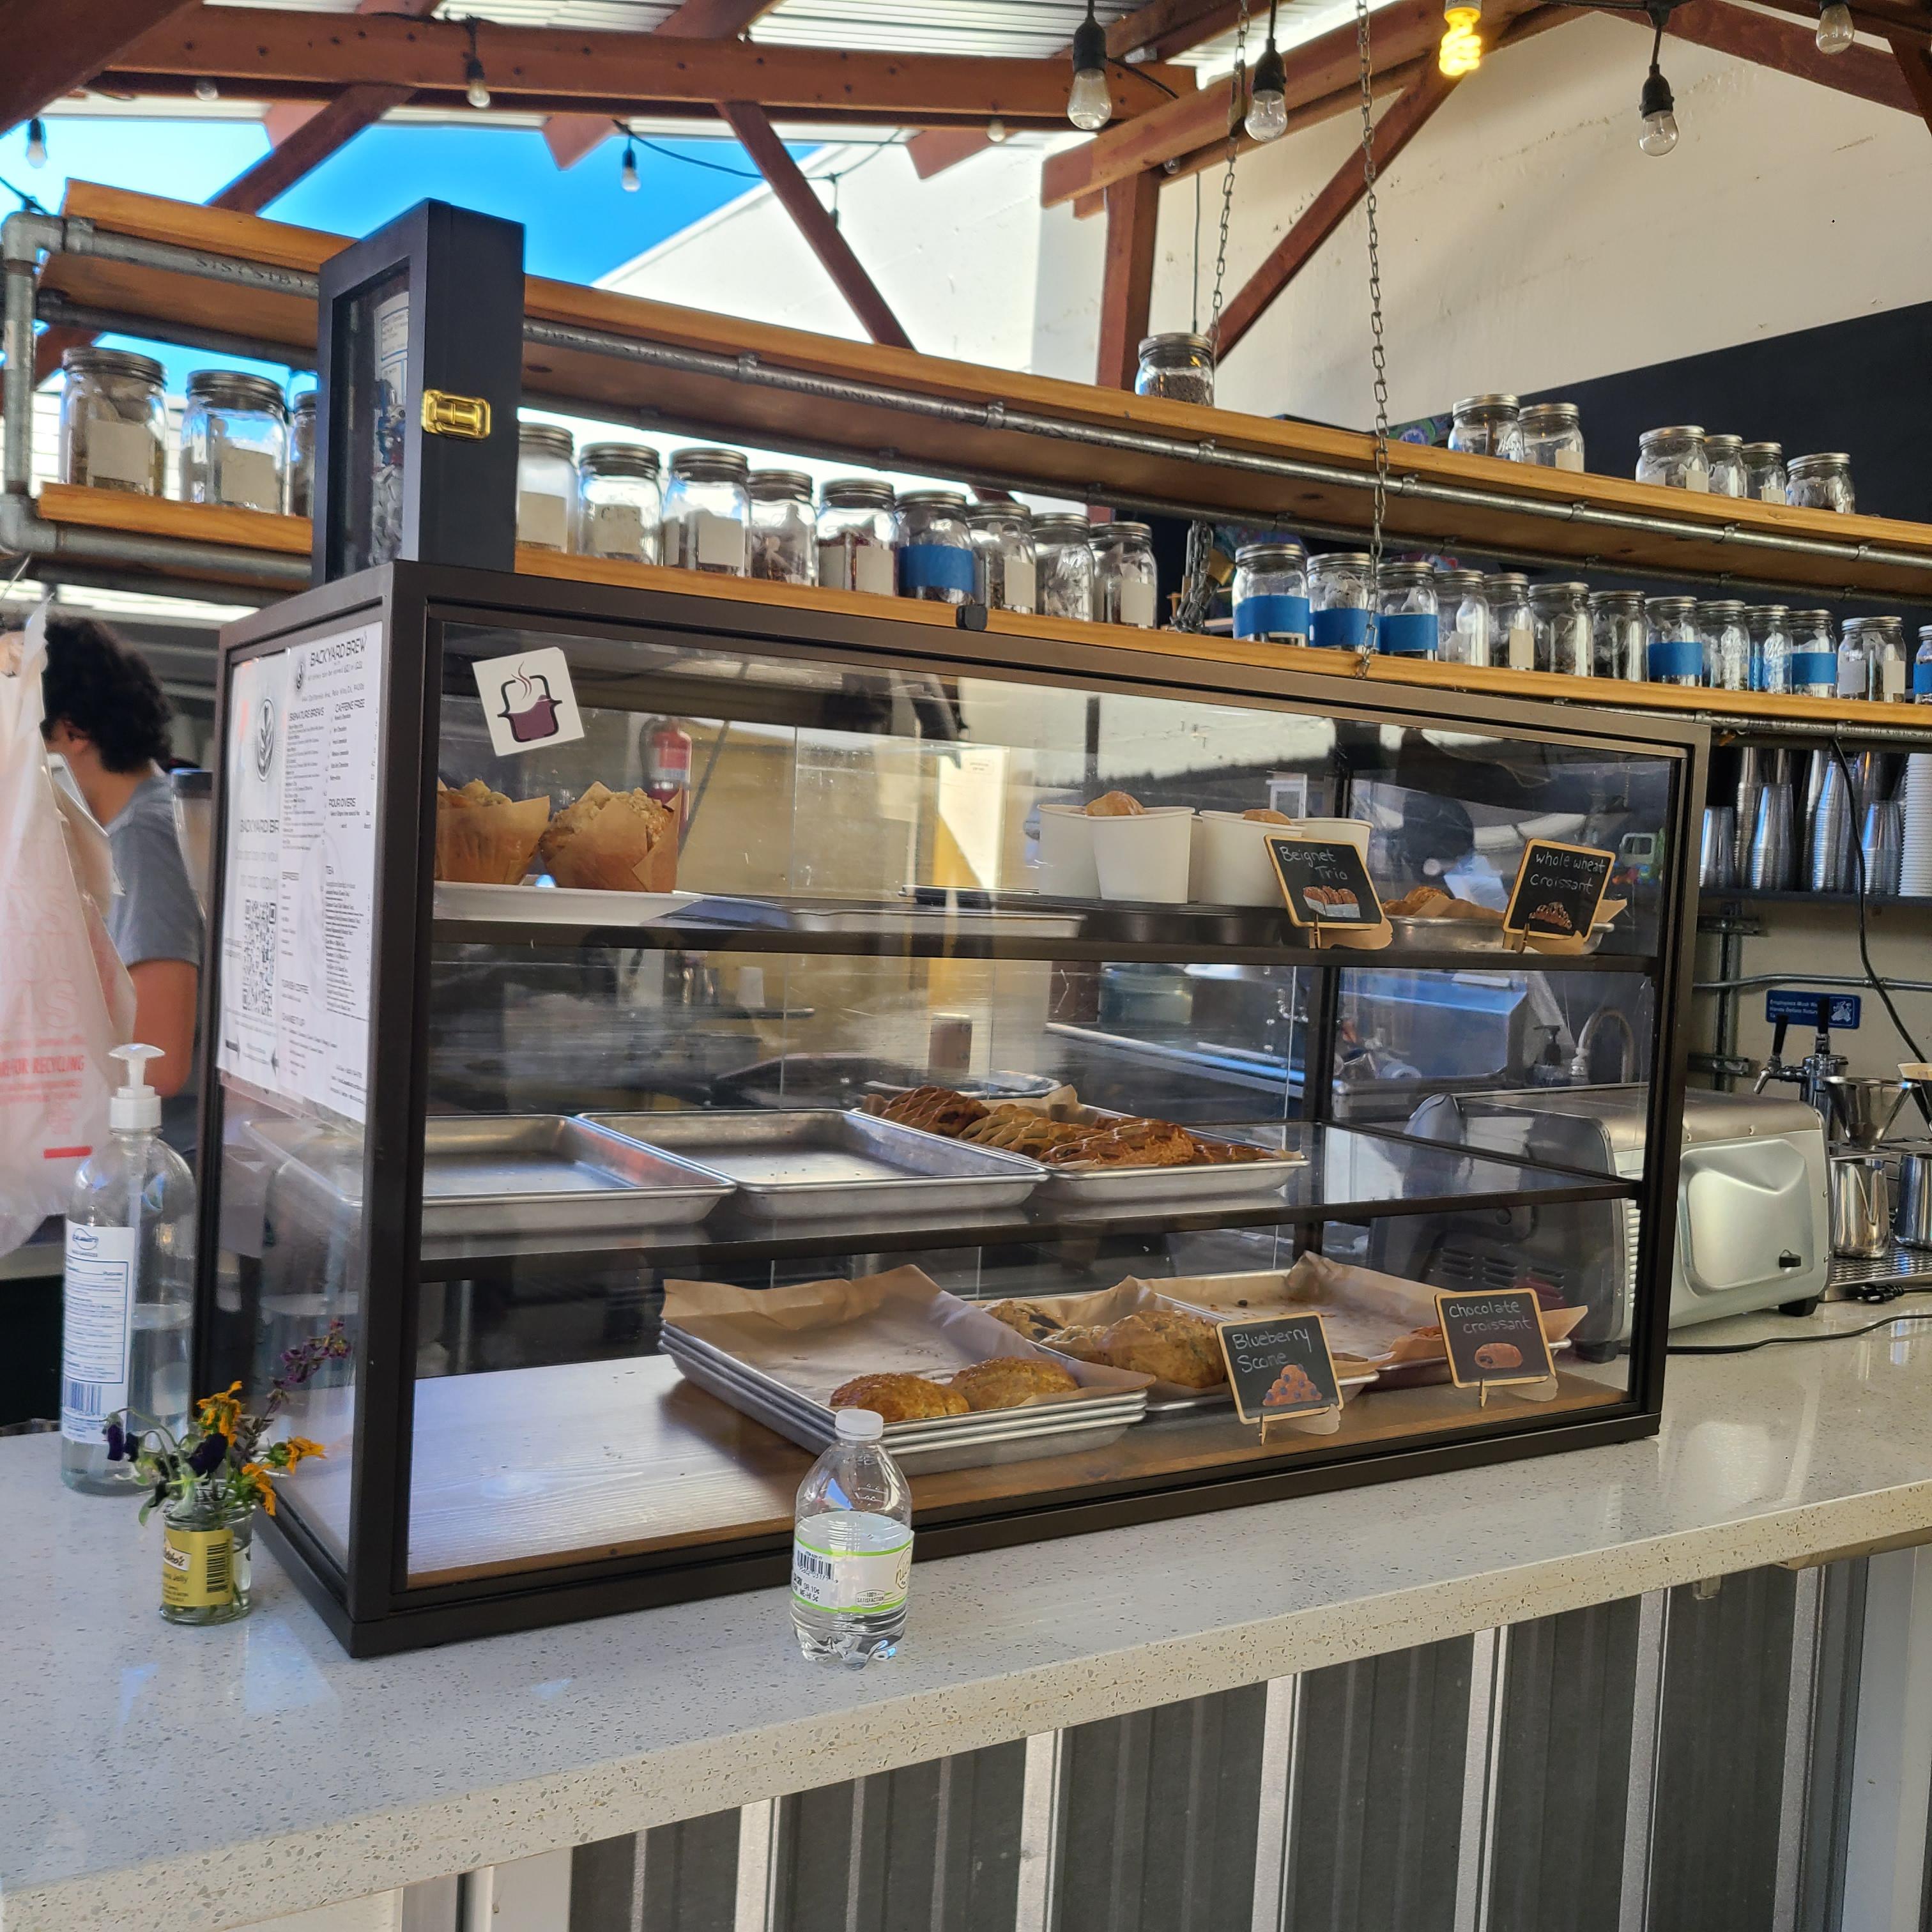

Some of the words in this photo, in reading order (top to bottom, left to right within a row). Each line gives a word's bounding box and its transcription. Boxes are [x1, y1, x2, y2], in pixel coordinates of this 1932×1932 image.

[346, 631, 367, 656] BREW
[1278, 846, 1336, 869] Beignet
[1535, 850, 1571, 869] whole
[1573, 854, 1606, 874] wheat
[1314, 865, 1348, 880] Trio
[1232, 1328, 1312, 1353] Blueberry
[1236, 1351, 1289, 1374] Scone
